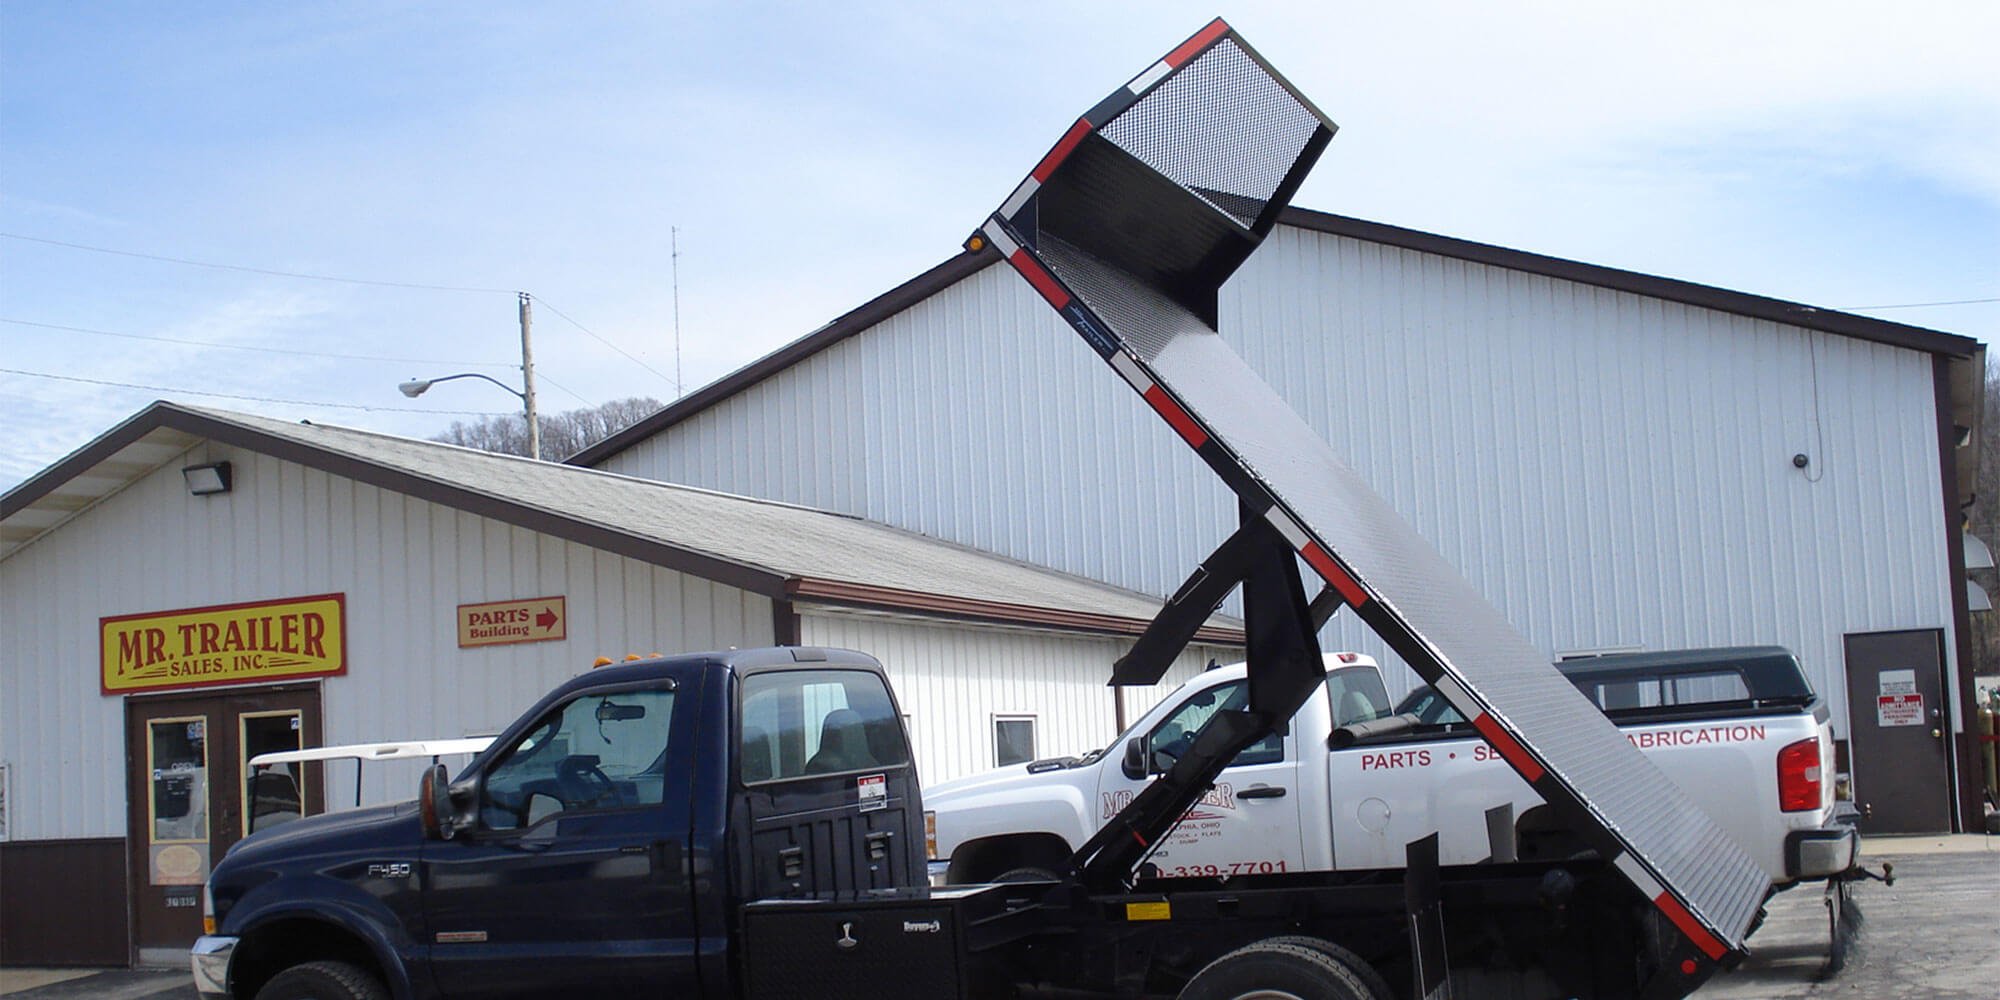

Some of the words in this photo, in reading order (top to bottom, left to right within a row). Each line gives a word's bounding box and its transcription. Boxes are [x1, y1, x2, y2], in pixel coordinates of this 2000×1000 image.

[468, 608, 530, 626] PARTS
[469, 625, 530, 639] Building
[117, 627, 174, 676] MR.
[177, 612, 327, 659] TRAILER
[233, 654, 268, 672] INC.
[1361, 750, 1432, 771] PARTS
[368, 863, 410, 876] F450
